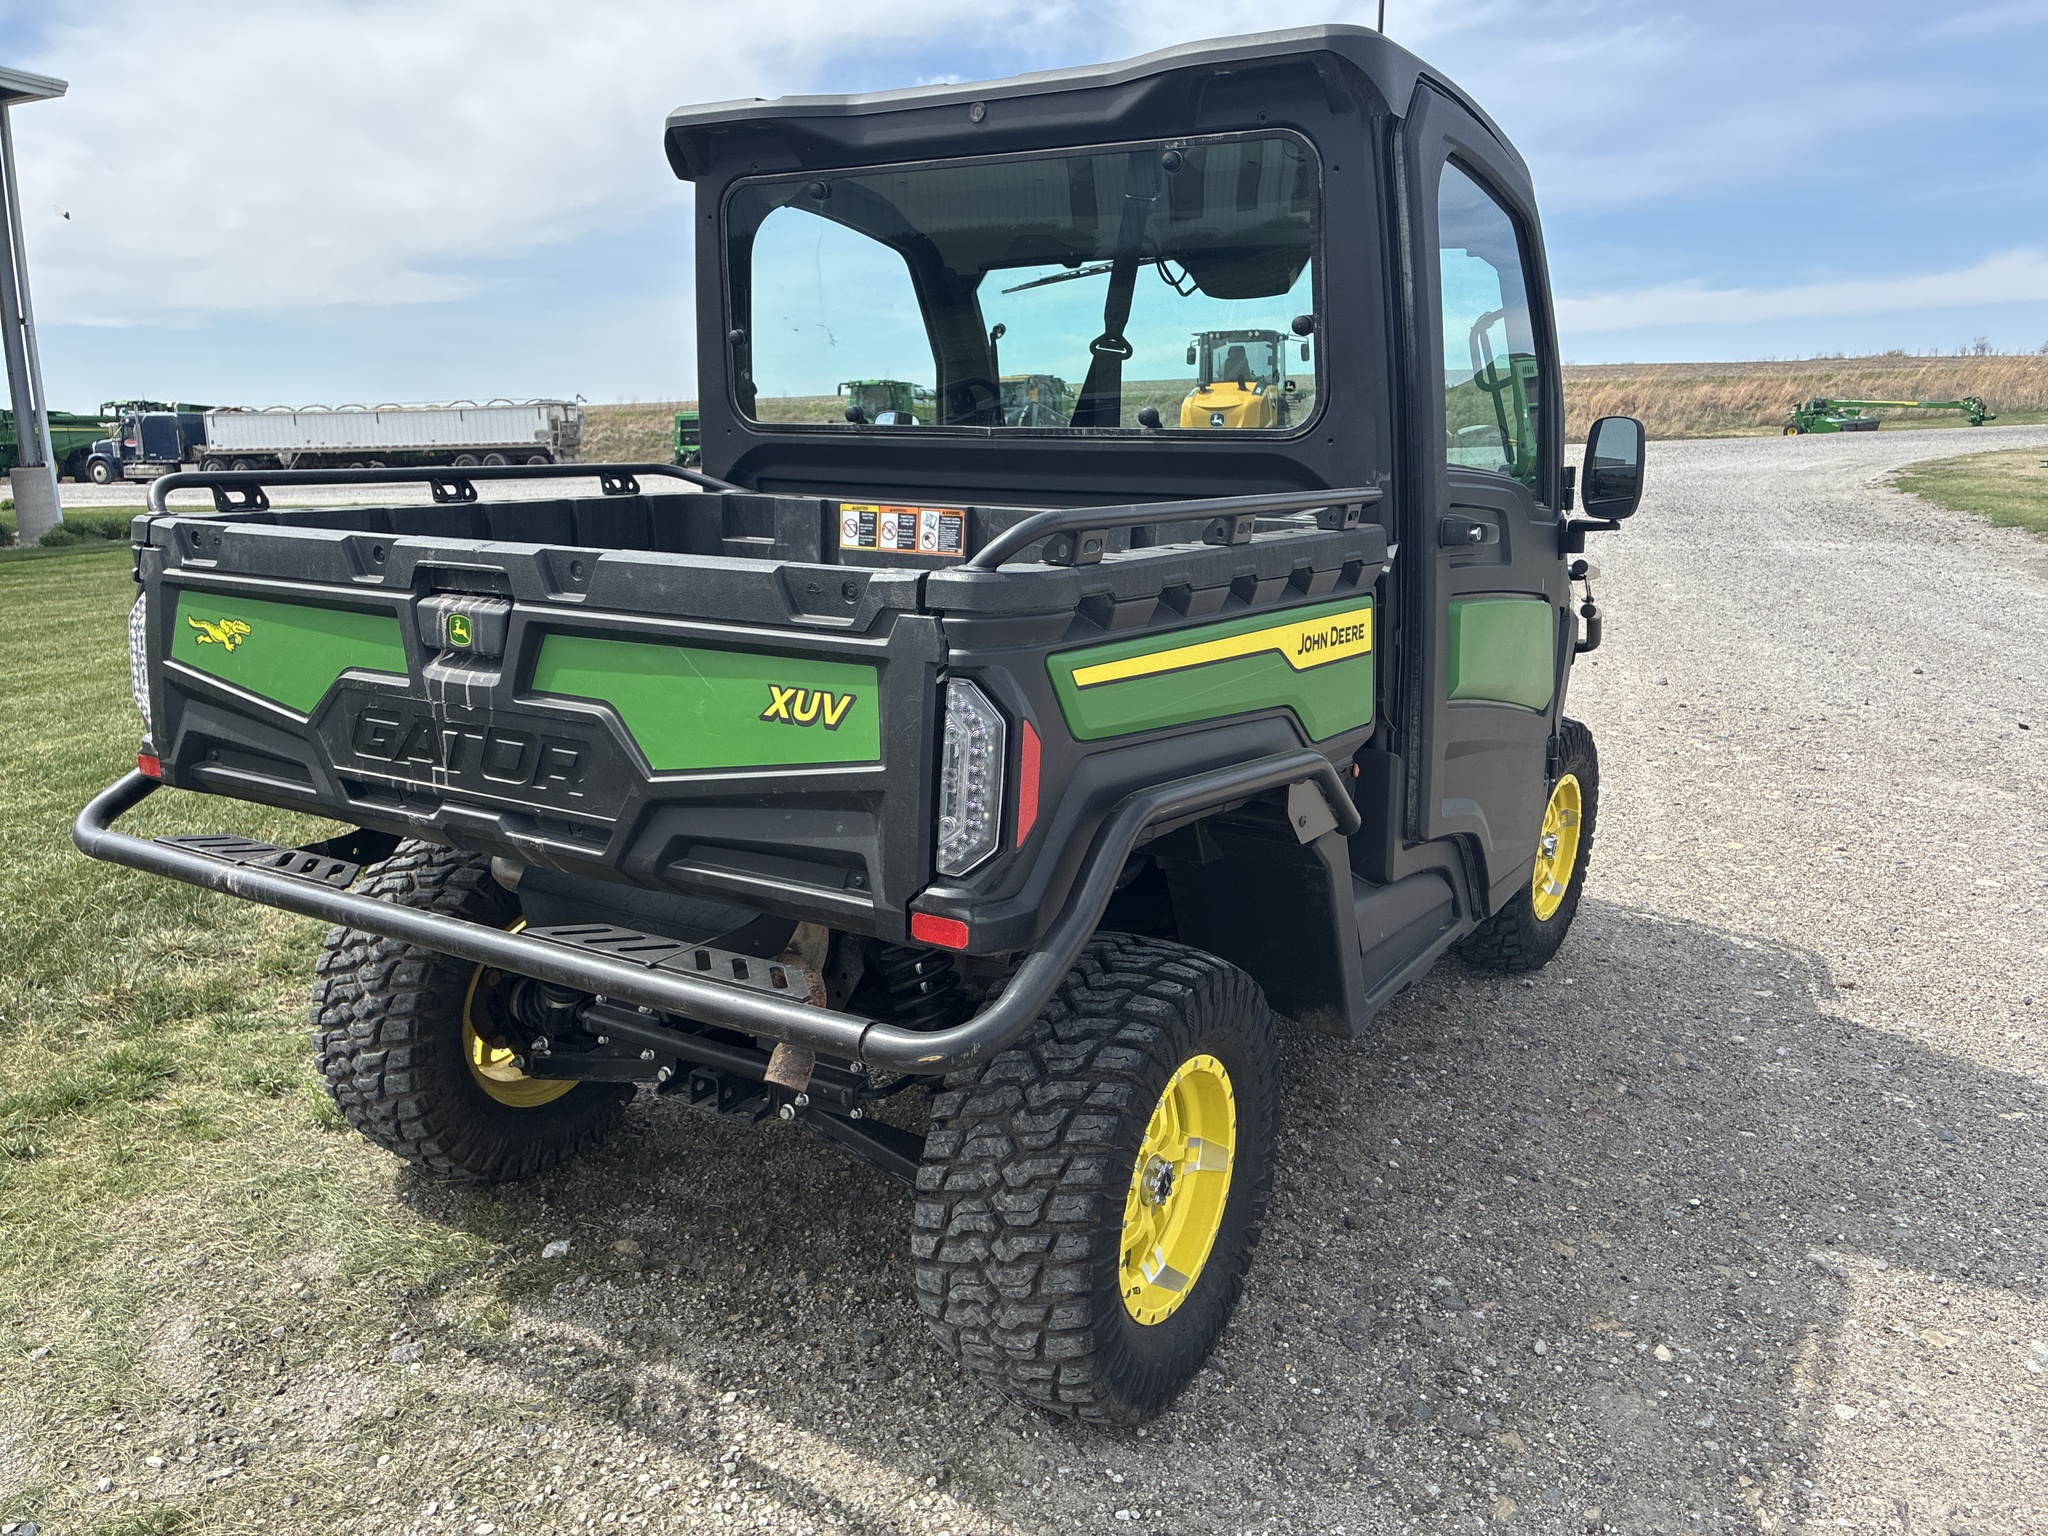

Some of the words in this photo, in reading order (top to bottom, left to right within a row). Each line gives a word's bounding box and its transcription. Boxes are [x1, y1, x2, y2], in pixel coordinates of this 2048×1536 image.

[1297, 632, 1328, 656] JOHN
[1330, 623, 1365, 647] DEERE
[759, 684, 858, 731] XUV
[352, 708, 593, 797] GATOR
